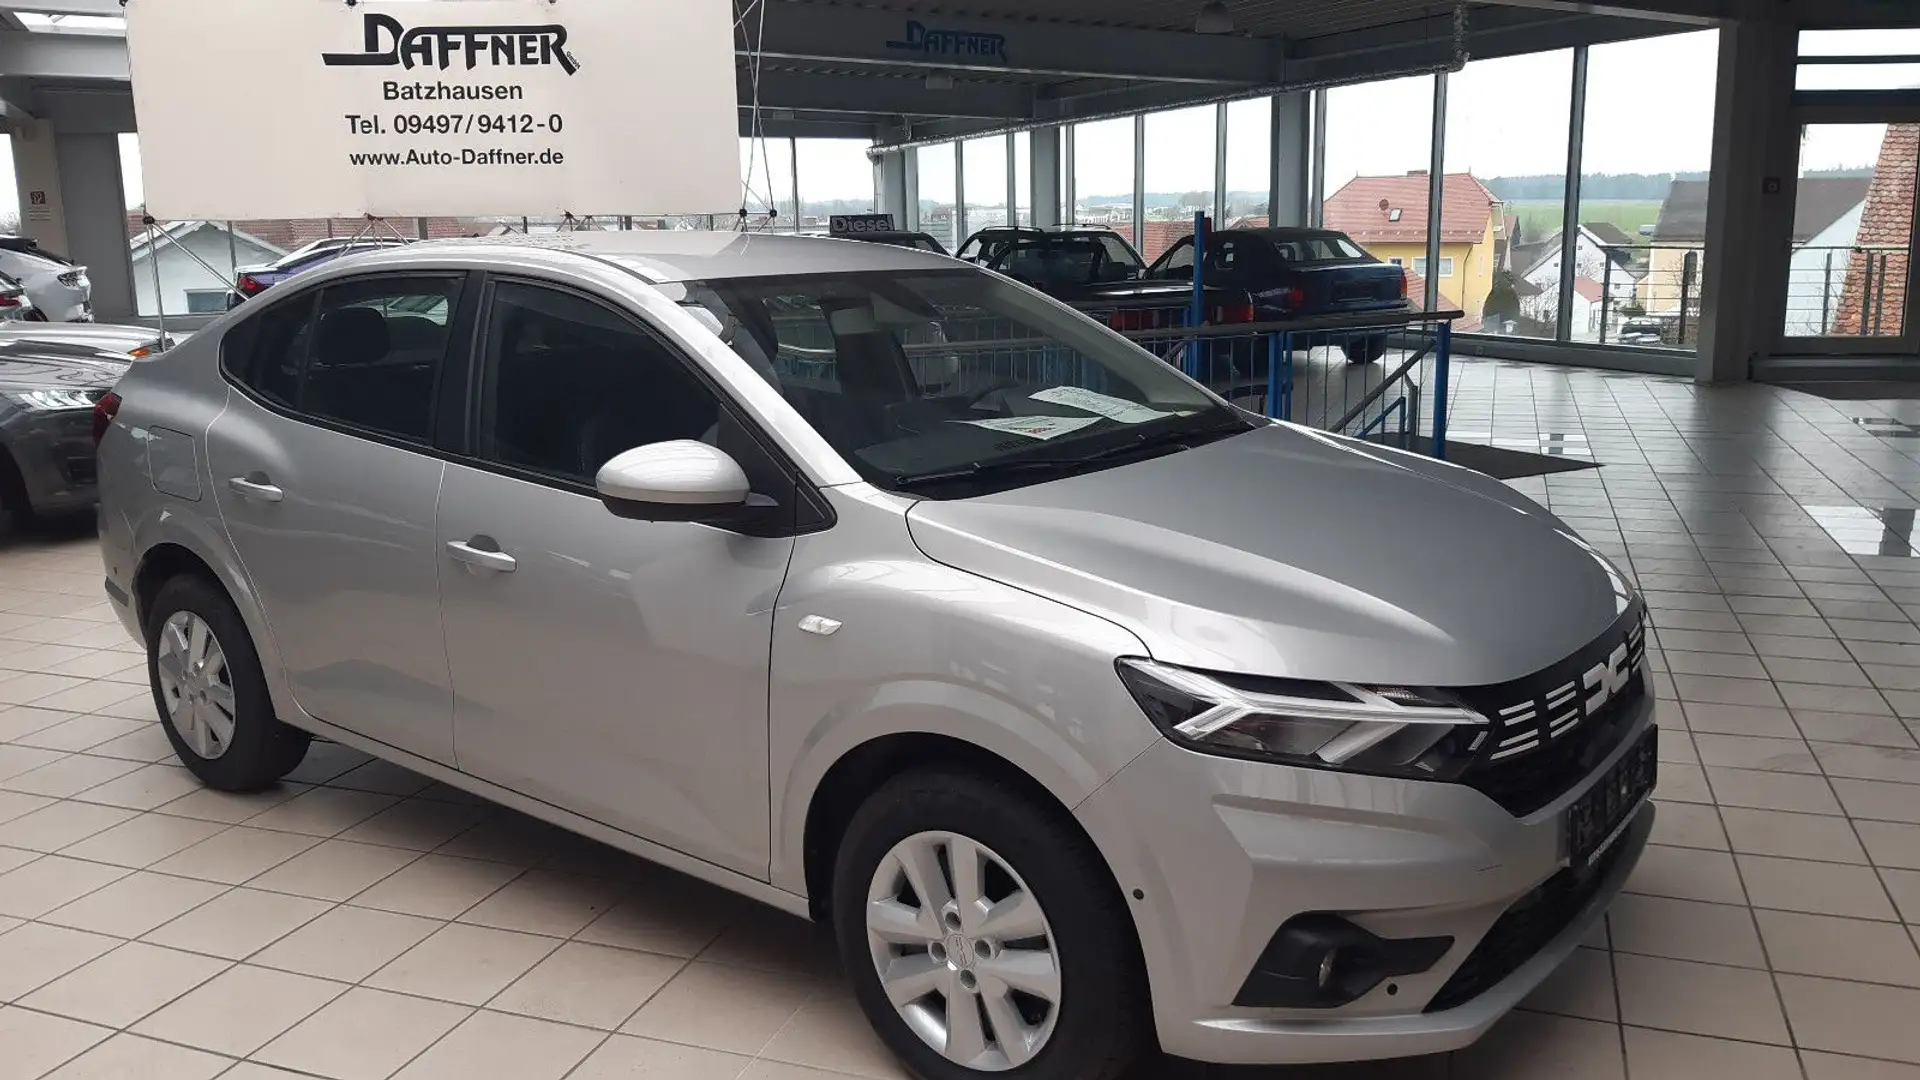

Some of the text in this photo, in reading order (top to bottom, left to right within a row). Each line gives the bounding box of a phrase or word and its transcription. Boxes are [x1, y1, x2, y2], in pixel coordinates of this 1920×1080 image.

[321, 13, 577, 76] DAFFNER
[886, 20, 1008, 63] DAFFNER
[383, 81, 523, 101] Batzhausen
[345, 114, 387, 134] Tel.
[349, 148, 564, 165] www.Auto-Daffner.de
[831, 216, 894, 232] Diesel
